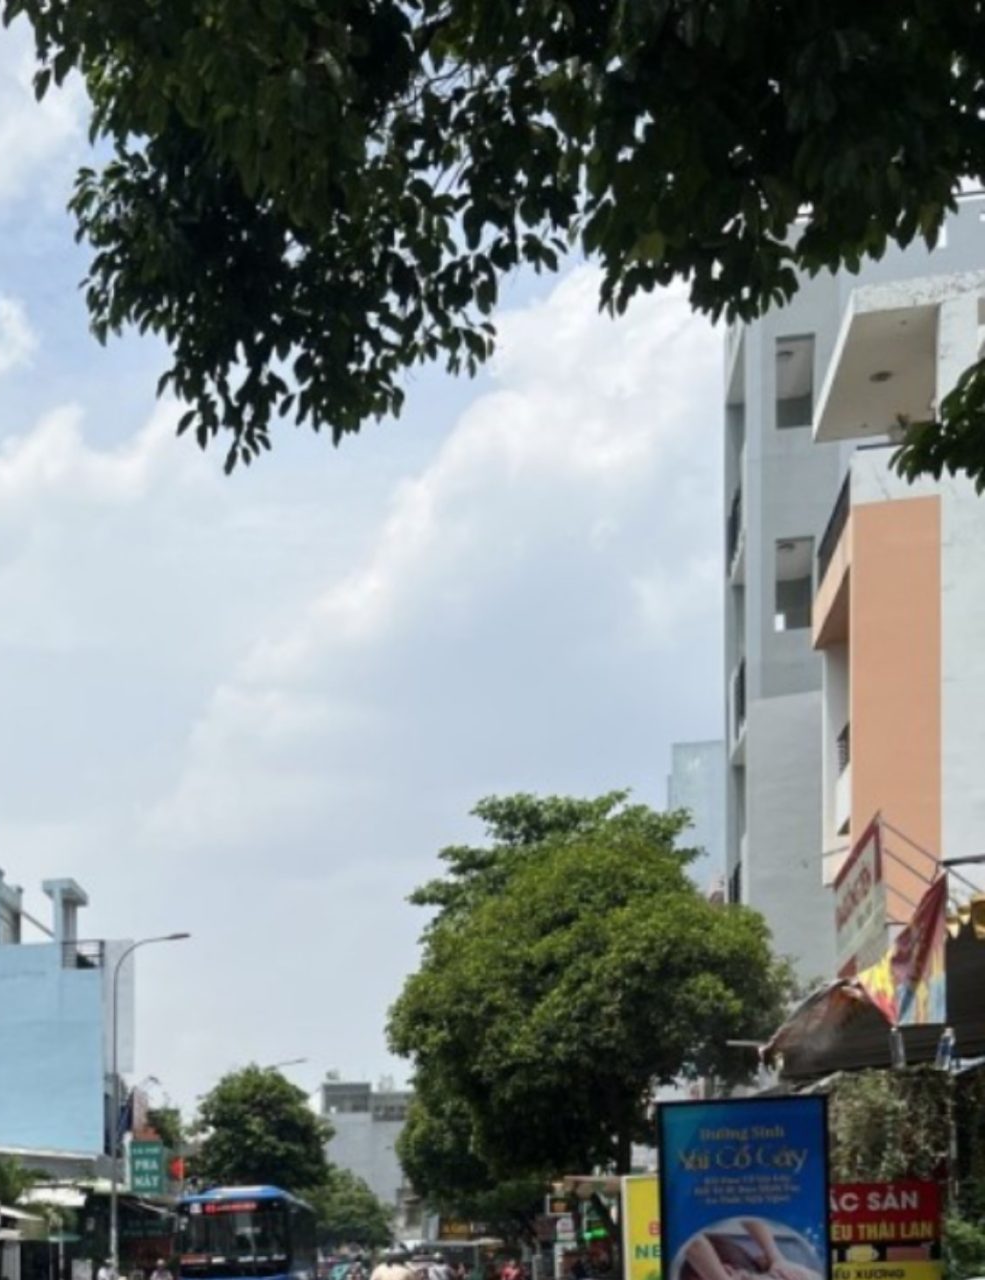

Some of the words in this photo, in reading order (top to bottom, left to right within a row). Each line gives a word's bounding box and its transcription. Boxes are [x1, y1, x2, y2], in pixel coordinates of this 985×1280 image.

[751, 1123, 785, 1138] Sinh
[866, 1185, 918, 1212] SẢN
[900, 1221, 933, 1239] LAN
